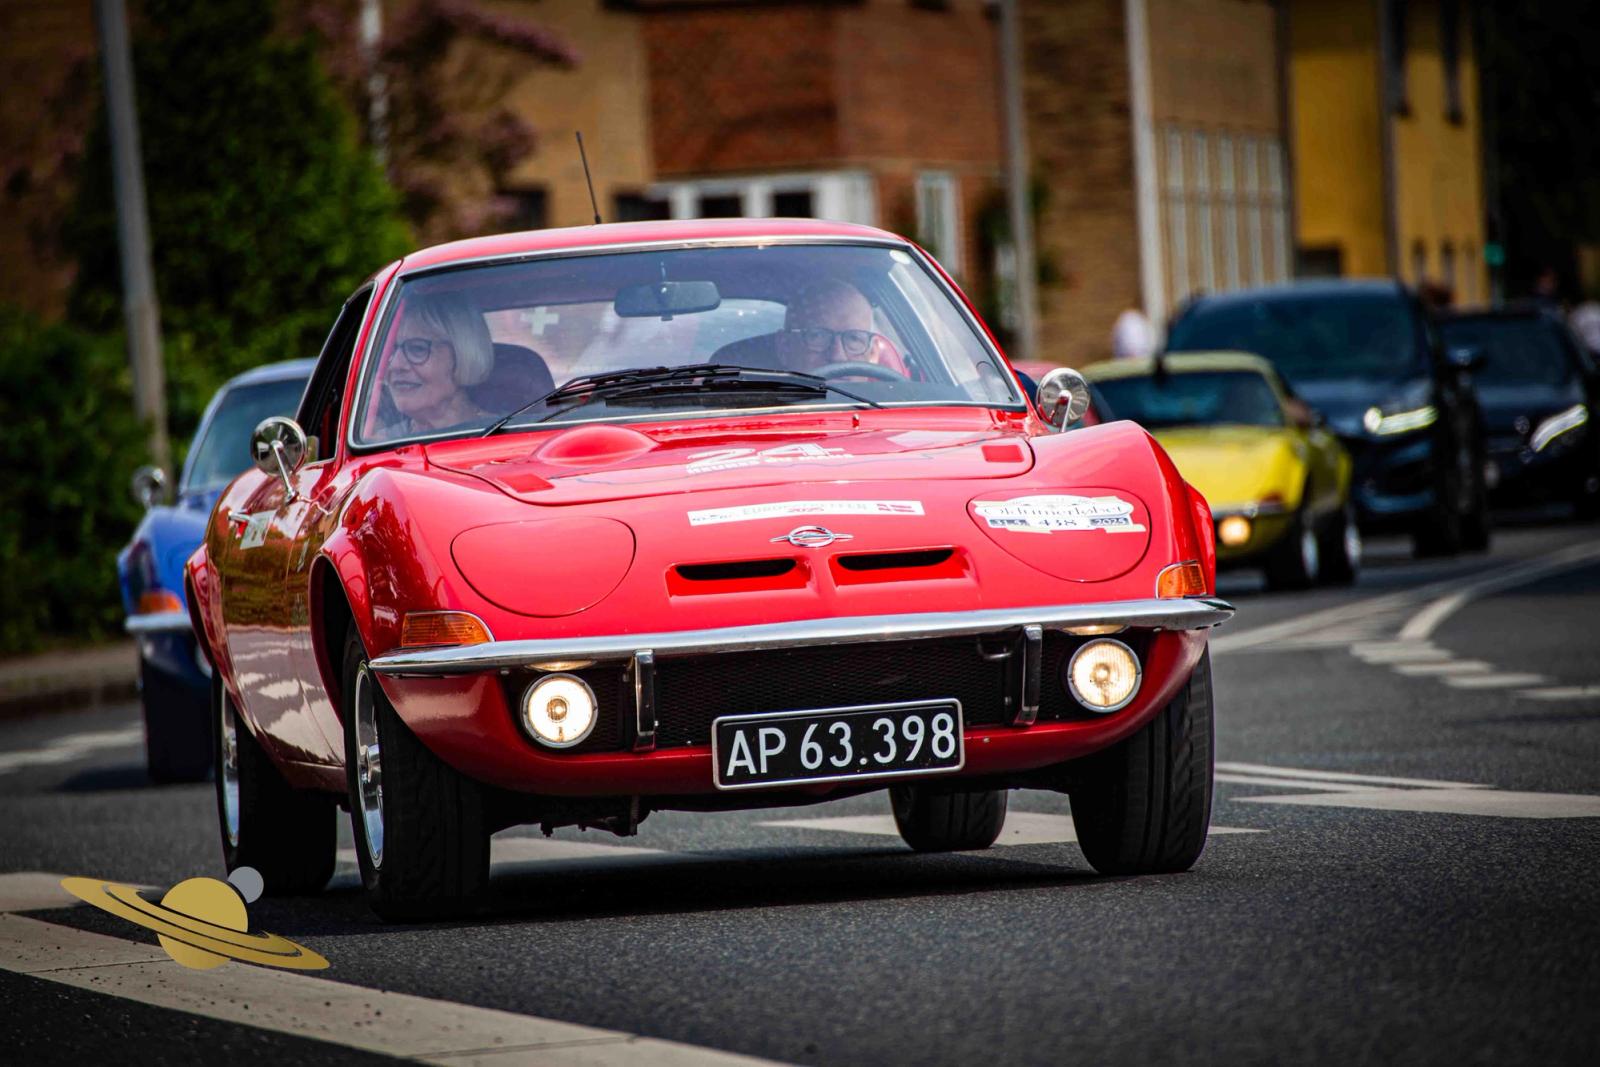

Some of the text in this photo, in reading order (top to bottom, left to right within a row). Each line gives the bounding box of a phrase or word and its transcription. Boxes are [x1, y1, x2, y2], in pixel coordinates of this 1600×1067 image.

[687, 443, 844, 468] 24
[726, 712, 956, 776] AP 63.398
